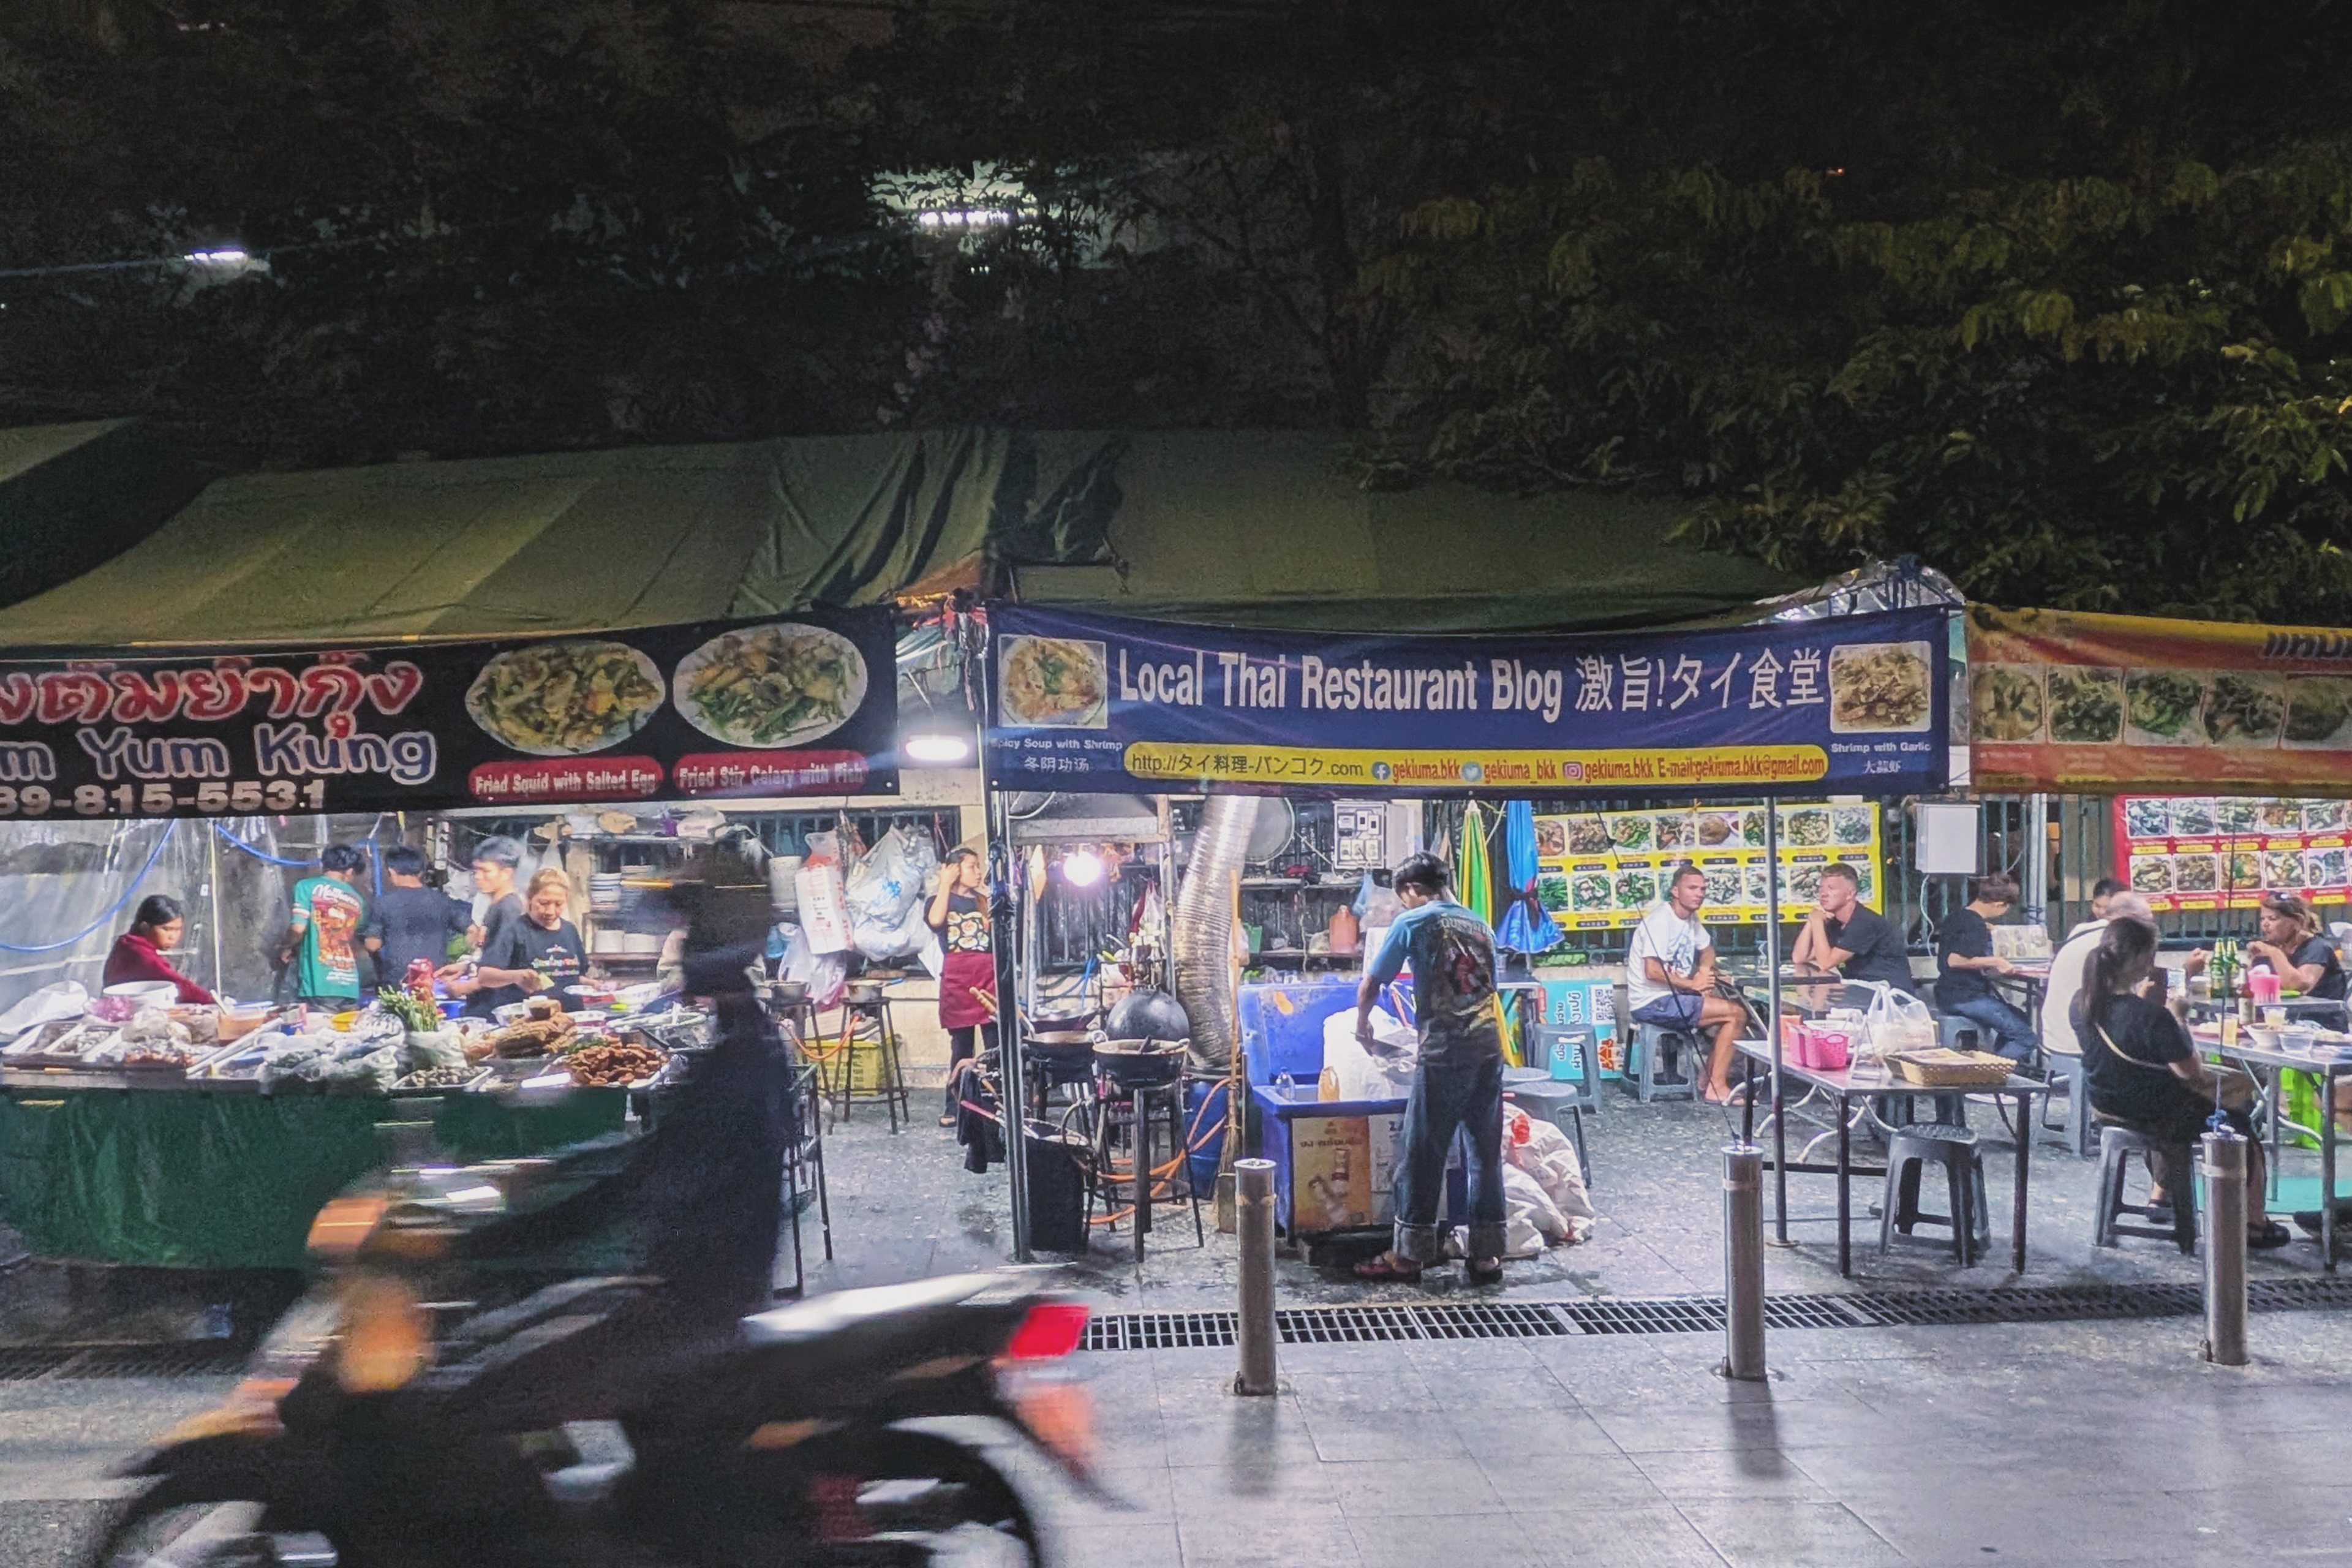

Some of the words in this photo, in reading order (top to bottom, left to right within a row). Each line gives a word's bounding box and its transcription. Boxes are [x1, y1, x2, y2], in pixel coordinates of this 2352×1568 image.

[1119, 648, 1204, 706] Local
[1219, 652, 1287, 708] Thai
[1301, 655, 1478, 710] Restaurant
[1490, 658, 1562, 723] Blog
[1575, 647, 1825, 712] 激旨!タイ食堂
[75, 726, 231, 780] Yum
[254, 722, 437, 786] Kung
[1023, 738, 1053, 748] Soup
[1056, 740, 1080, 748] with
[1084, 739, 1123, 752] Shrimp
[1831, 743, 1870, 753] Shrimp
[1874, 742, 1897, 752] with
[1899, 742, 1931, 752] Garlic
[679, 766, 715, 788] Fried
[800, 762, 829, 784] with
[1132, 753, 1364, 777] http://タイ料理-バンコク.com
[1392, 759, 1461, 783] gekiuma.bkk
[1483, 759, 1557, 784] gekiuma_bkk
[1585, 758, 1654, 783] gekiuma.bkk
[475, 775, 508, 794] Fried
[513, 772, 549, 797] Squid
[553, 771, 581, 791] with
[586, 769, 627, 791] Salted
[631, 769, 655, 795] Egg
